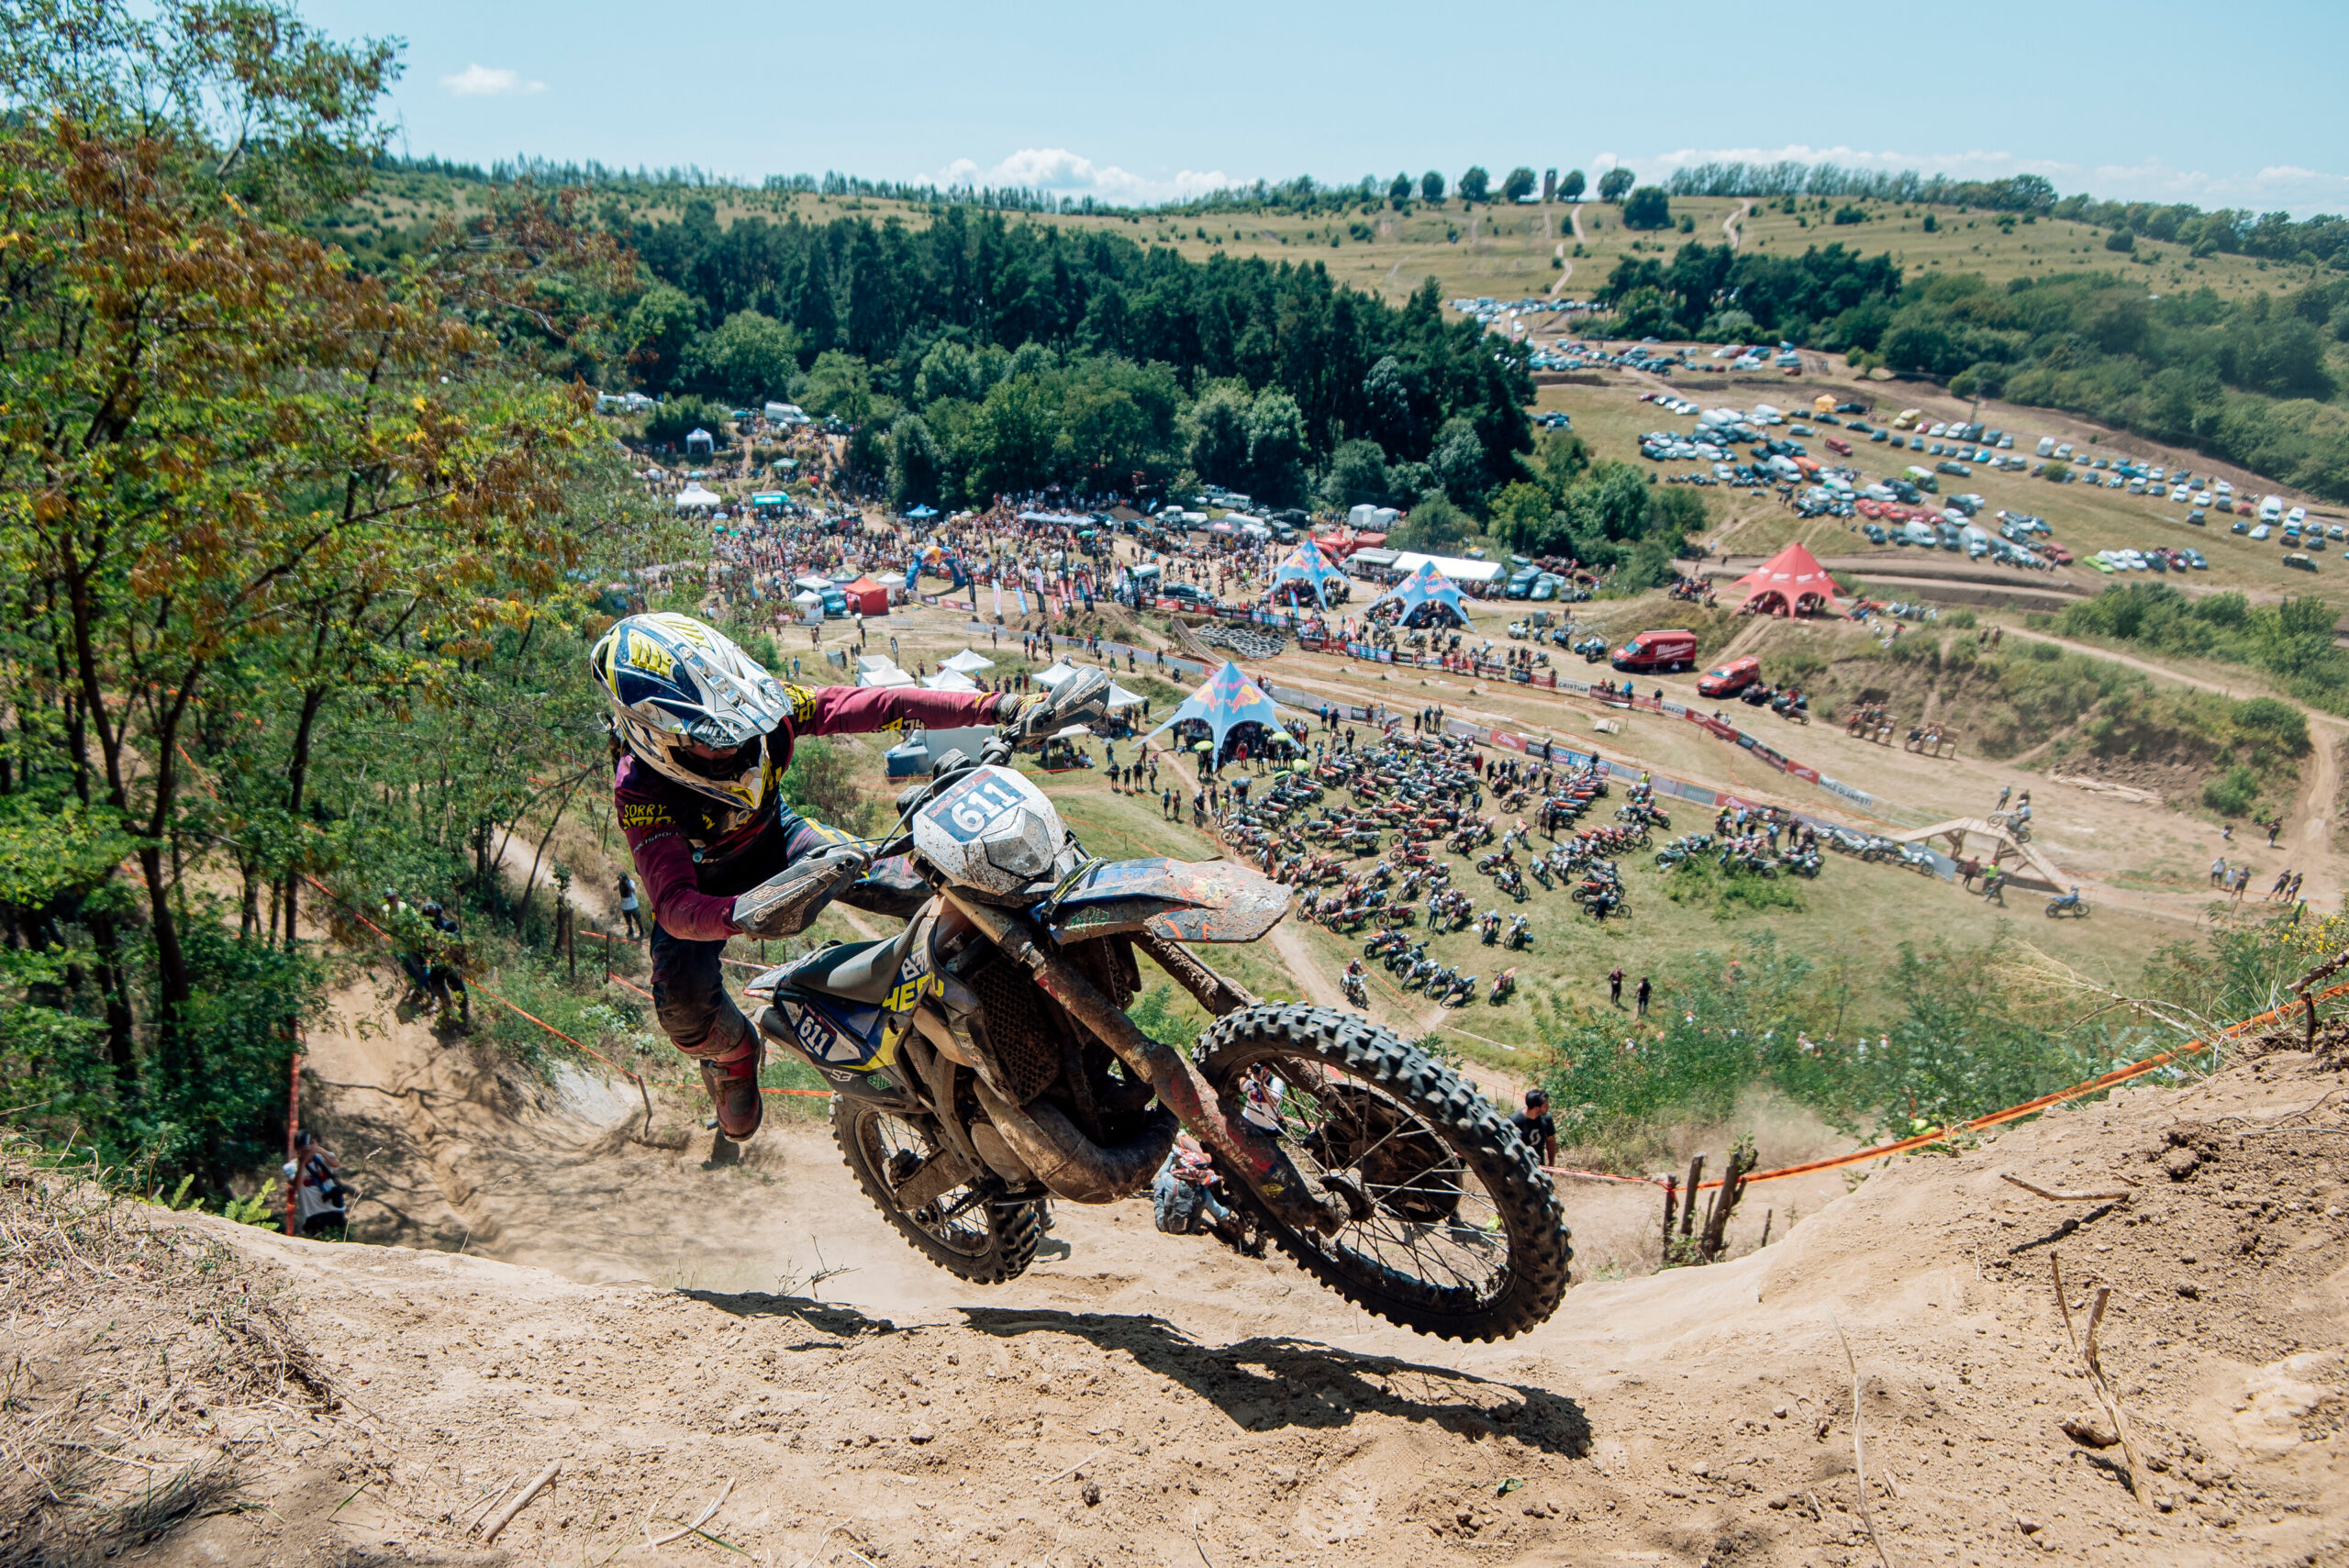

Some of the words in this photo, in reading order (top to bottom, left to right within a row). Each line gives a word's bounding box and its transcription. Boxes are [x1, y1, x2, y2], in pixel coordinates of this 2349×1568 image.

[1558, 682, 1588, 692] CRISTIAN
[624, 804, 667, 817] SORRY
[952, 783, 1019, 832] 611
[800, 1016, 830, 1056] 611
